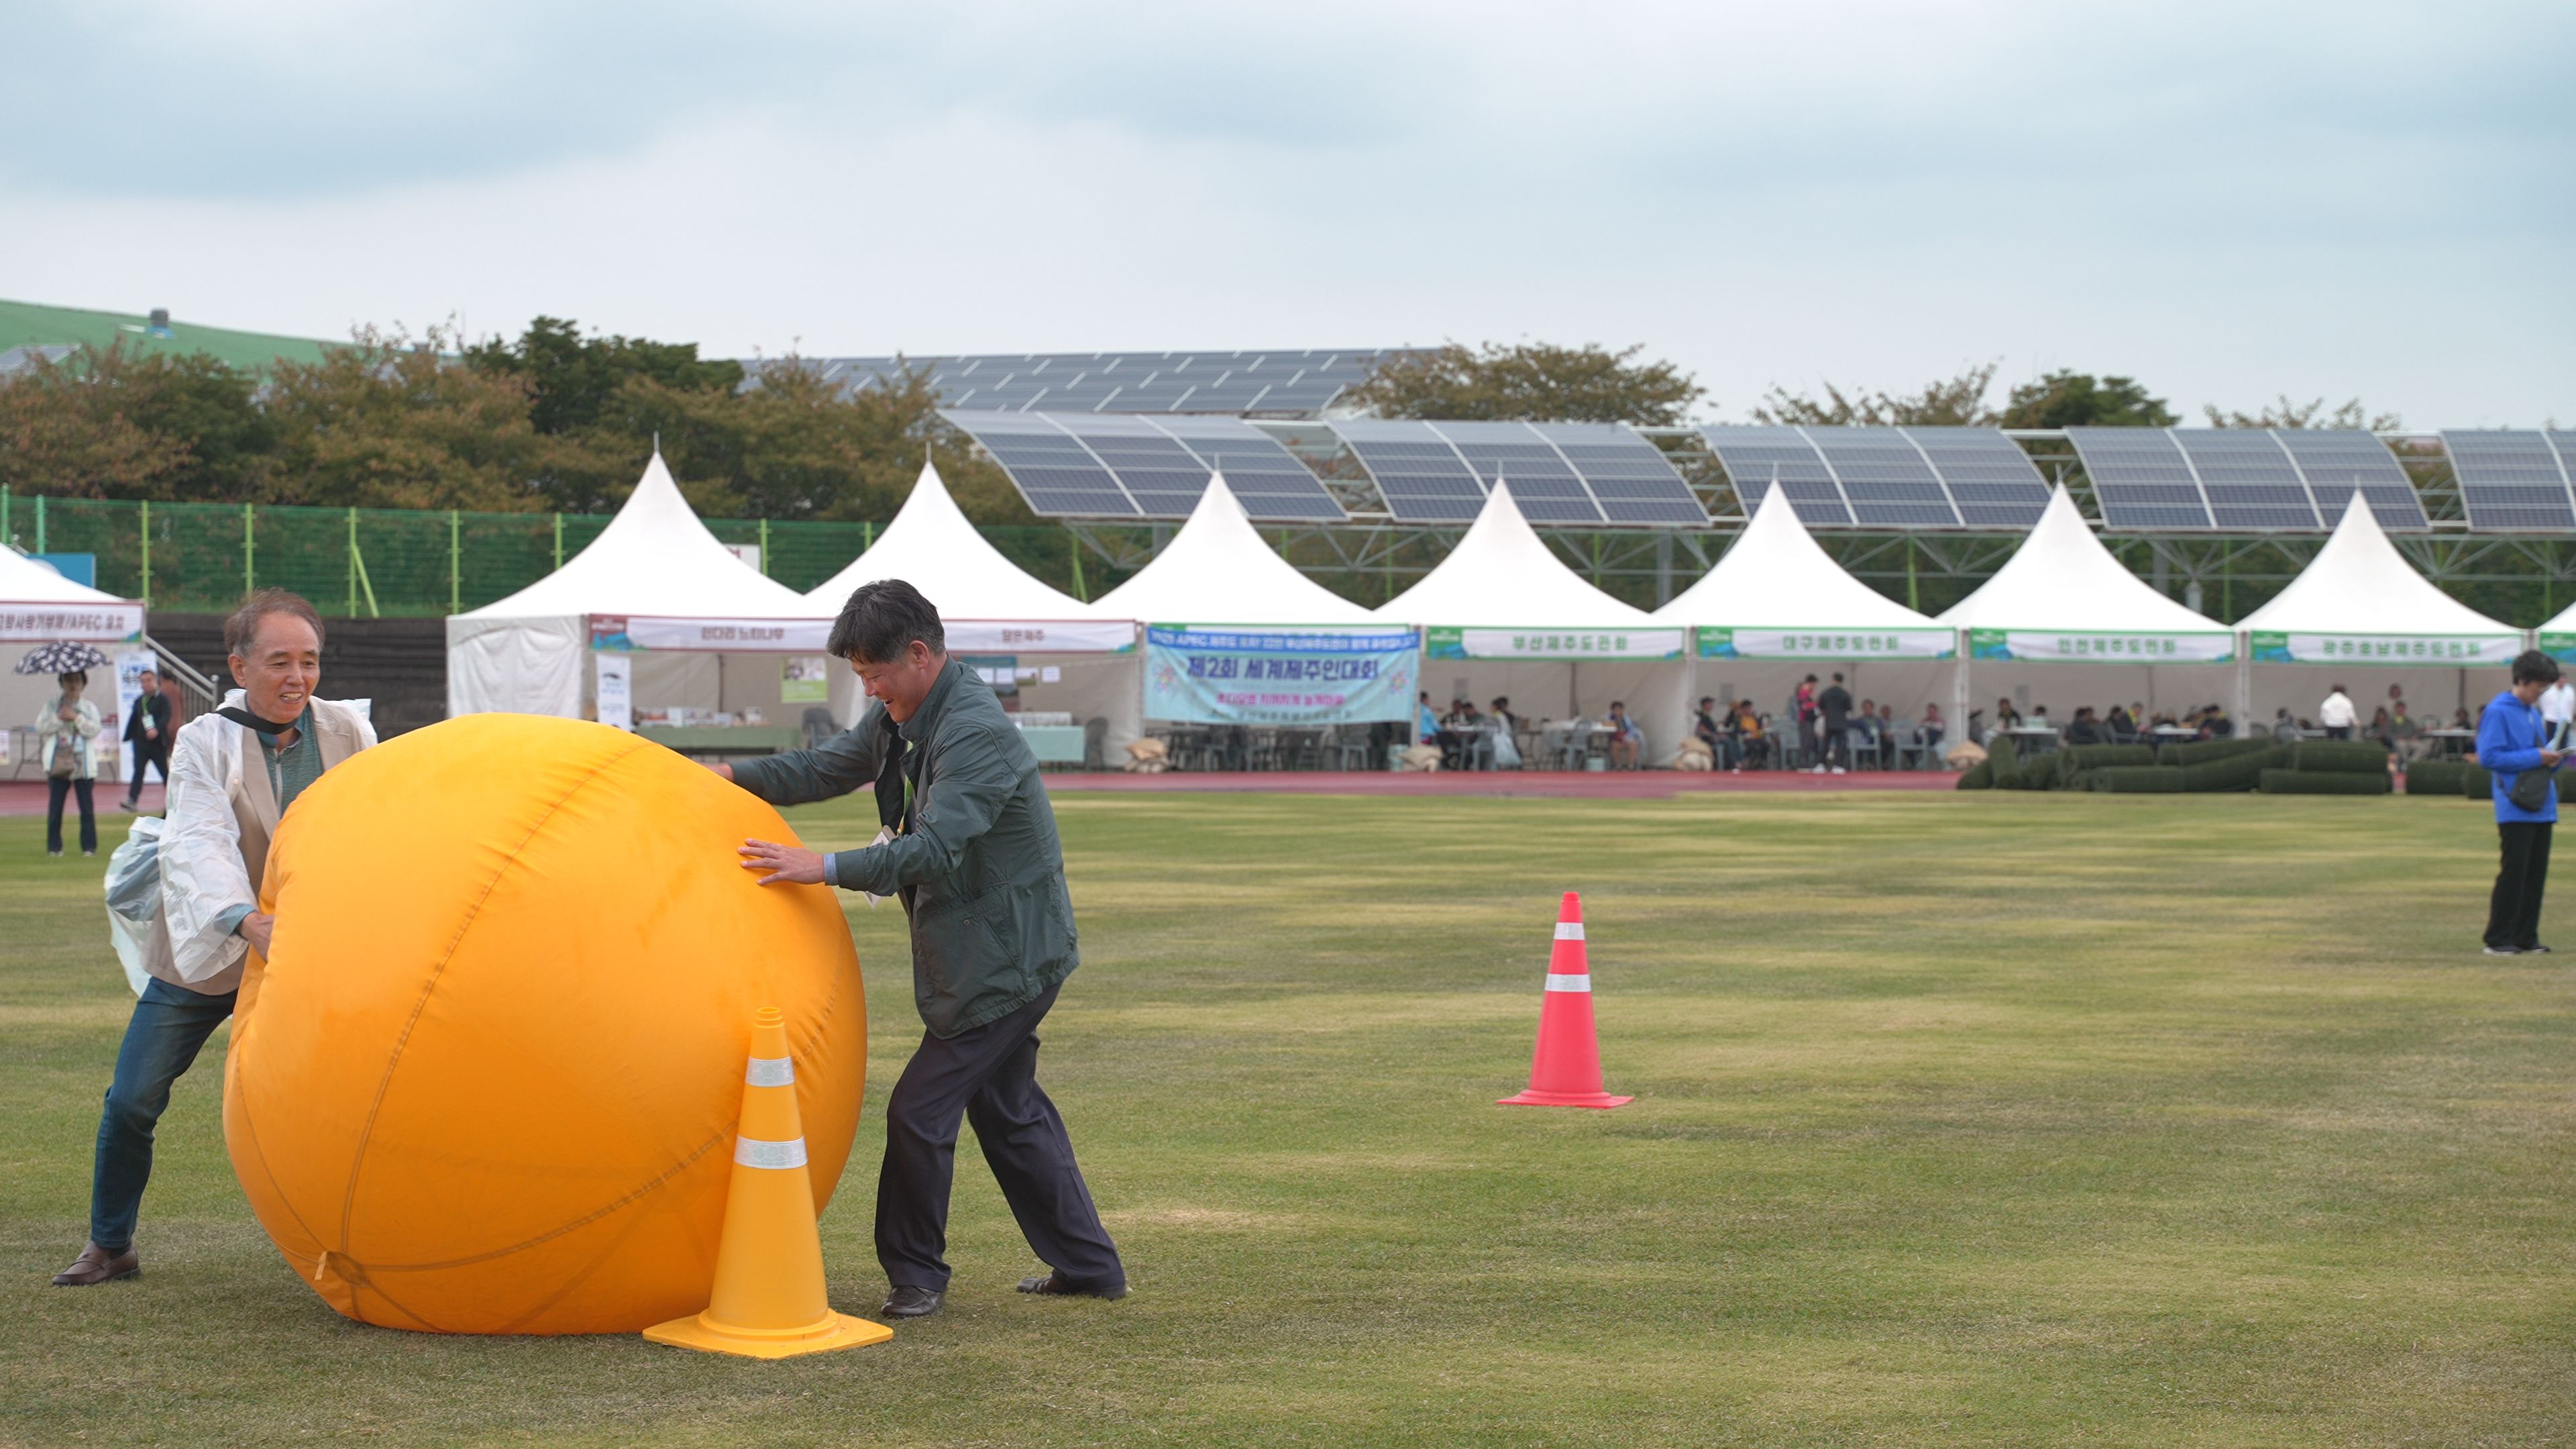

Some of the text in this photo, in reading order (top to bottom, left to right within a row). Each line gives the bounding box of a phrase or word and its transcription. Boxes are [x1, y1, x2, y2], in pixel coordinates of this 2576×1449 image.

[1513, 635, 1628, 651] 부산제주도민회
[1782, 635, 1899, 651] 대구제주도민회
[2058, 638, 2176, 654] 인천제주도민회
[2323, 639, 2481, 657] 광주호남제주도민회
[1187, 655, 1379, 681] 제2회 세계제주인대회
